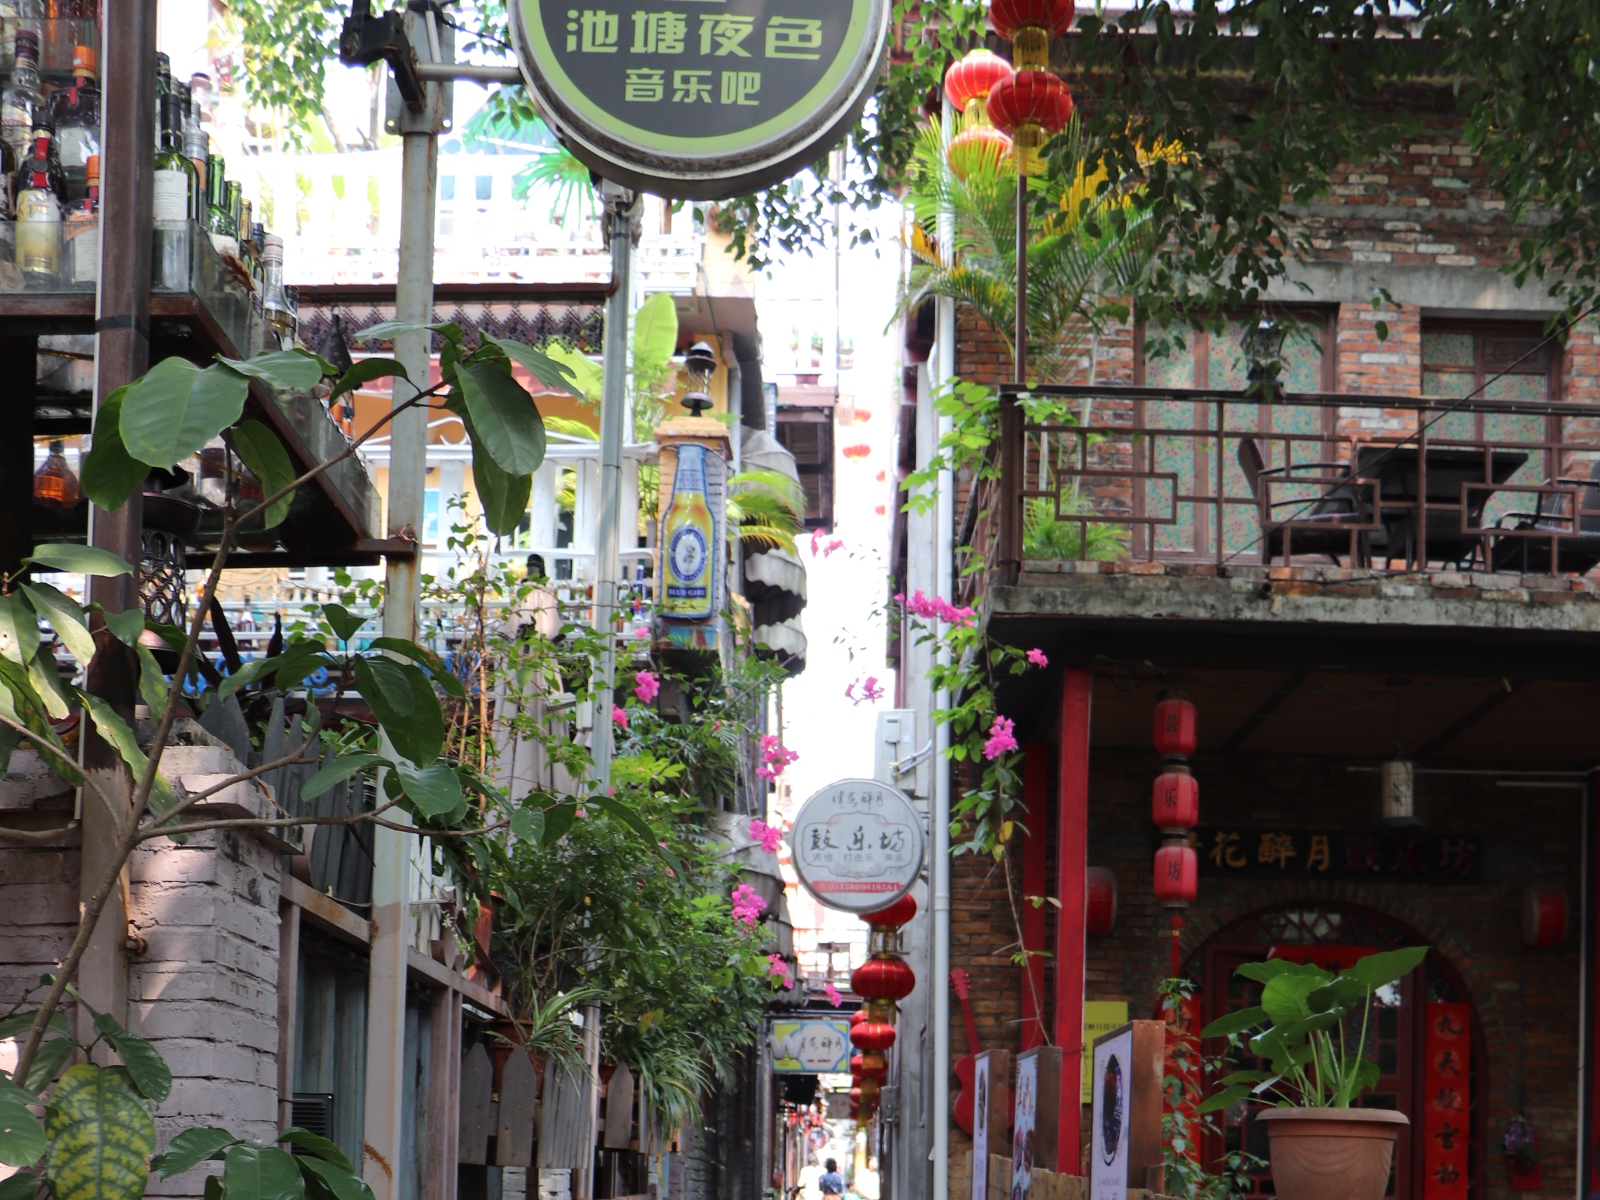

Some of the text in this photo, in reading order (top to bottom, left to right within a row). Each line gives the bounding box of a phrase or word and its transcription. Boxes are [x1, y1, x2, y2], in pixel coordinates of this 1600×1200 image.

[566, 9, 823, 60] 池塘夜色
[624, 67, 762, 106] 音乐吧
[802, 1036, 842, 1055] 花醉月
